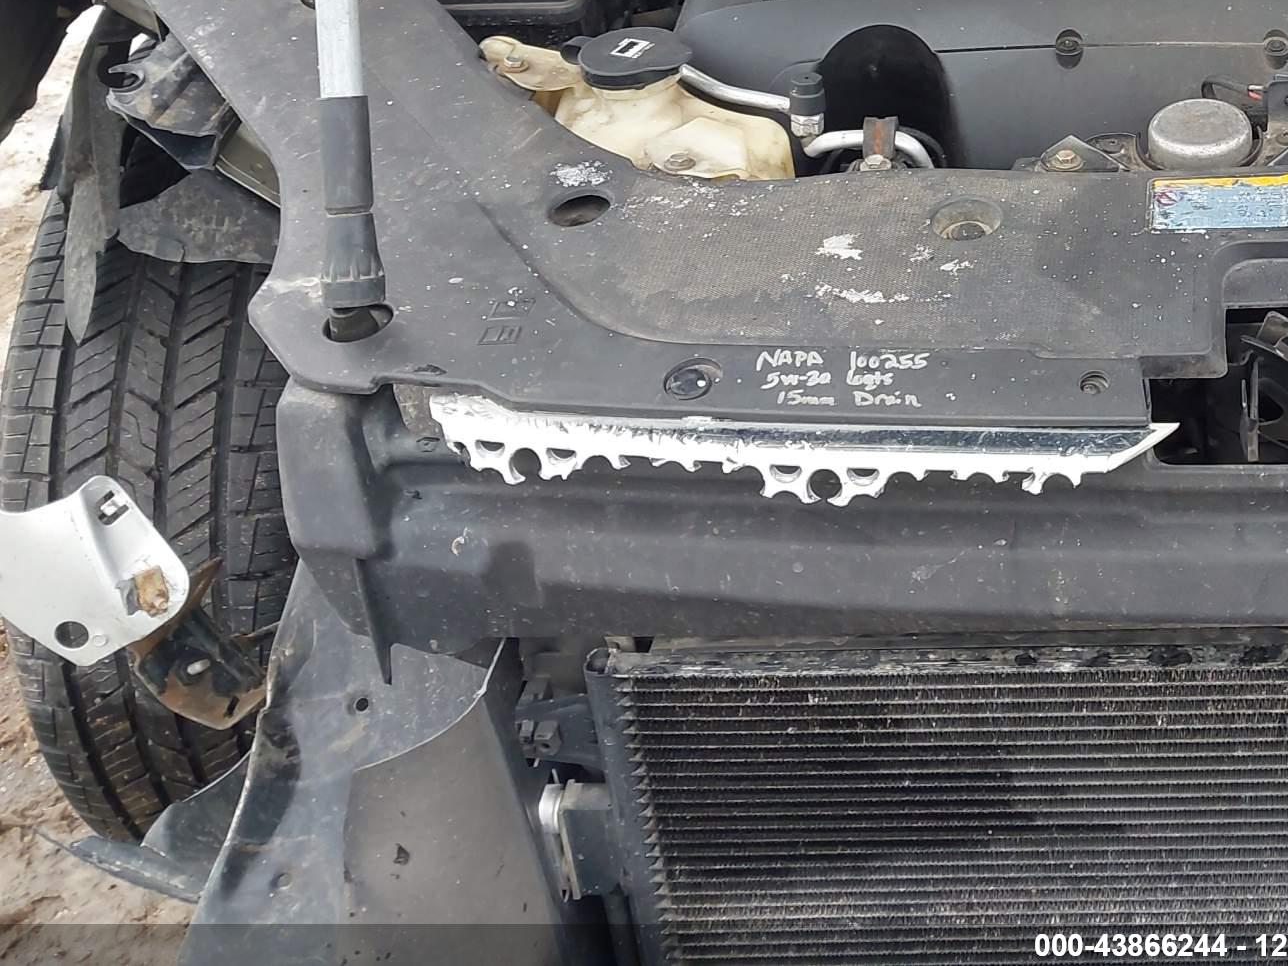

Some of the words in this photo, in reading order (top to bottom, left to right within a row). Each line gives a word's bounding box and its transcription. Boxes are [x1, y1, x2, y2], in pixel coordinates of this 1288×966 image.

[756, 349, 824, 371] NAPA
[850, 351, 931, 369] 100255
[853, 391, 923, 408] Drain
